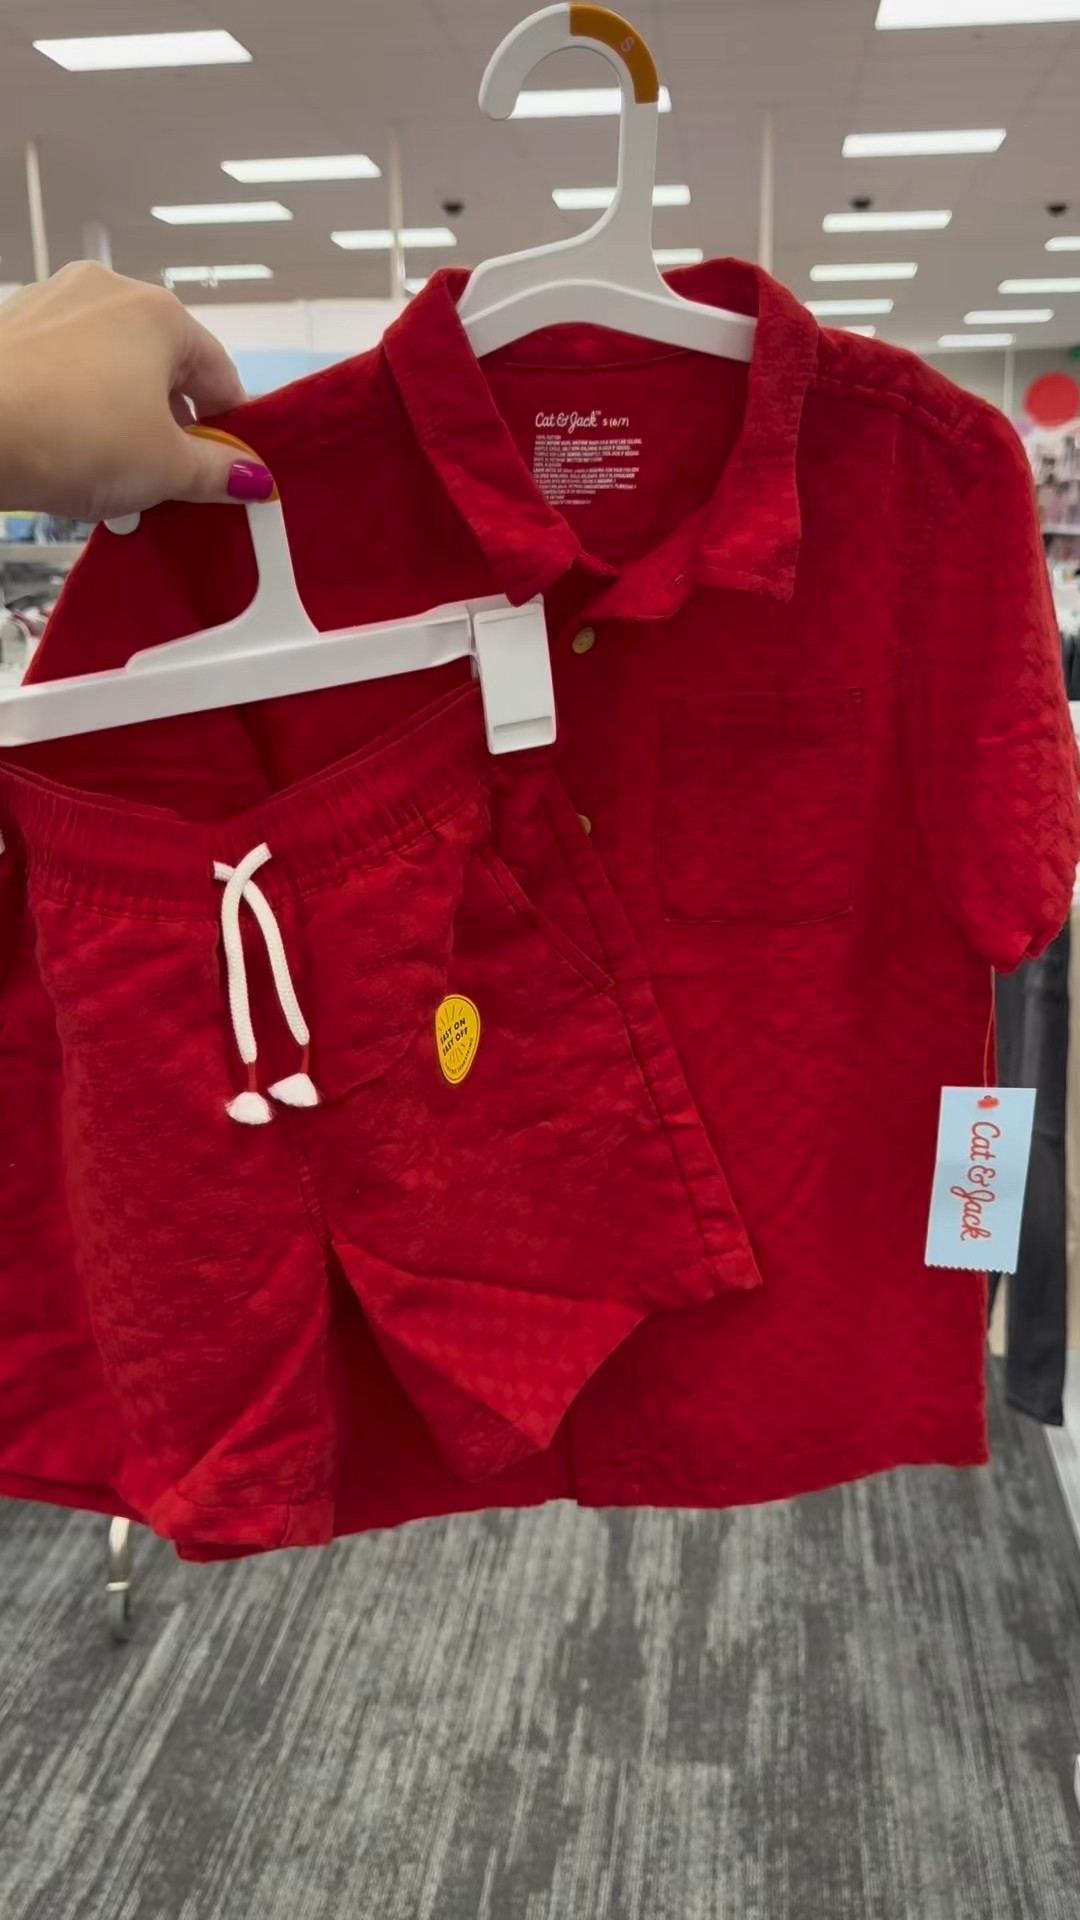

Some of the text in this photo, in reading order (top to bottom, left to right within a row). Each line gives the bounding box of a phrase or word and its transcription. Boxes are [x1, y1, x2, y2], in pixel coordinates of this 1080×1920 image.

[535, 411, 556, 428] Cat
[556, 413, 569, 428] &
[602, 418, 608, 427] S
[609, 417, 630, 428] (6/7)
[440, 1017, 466, 1045] EASY ON
[442, 1038, 455, 1057] EASY
[455, 1027, 468, 1041] OFF
[949, 1121, 1001, 1241] Cat & Jack
